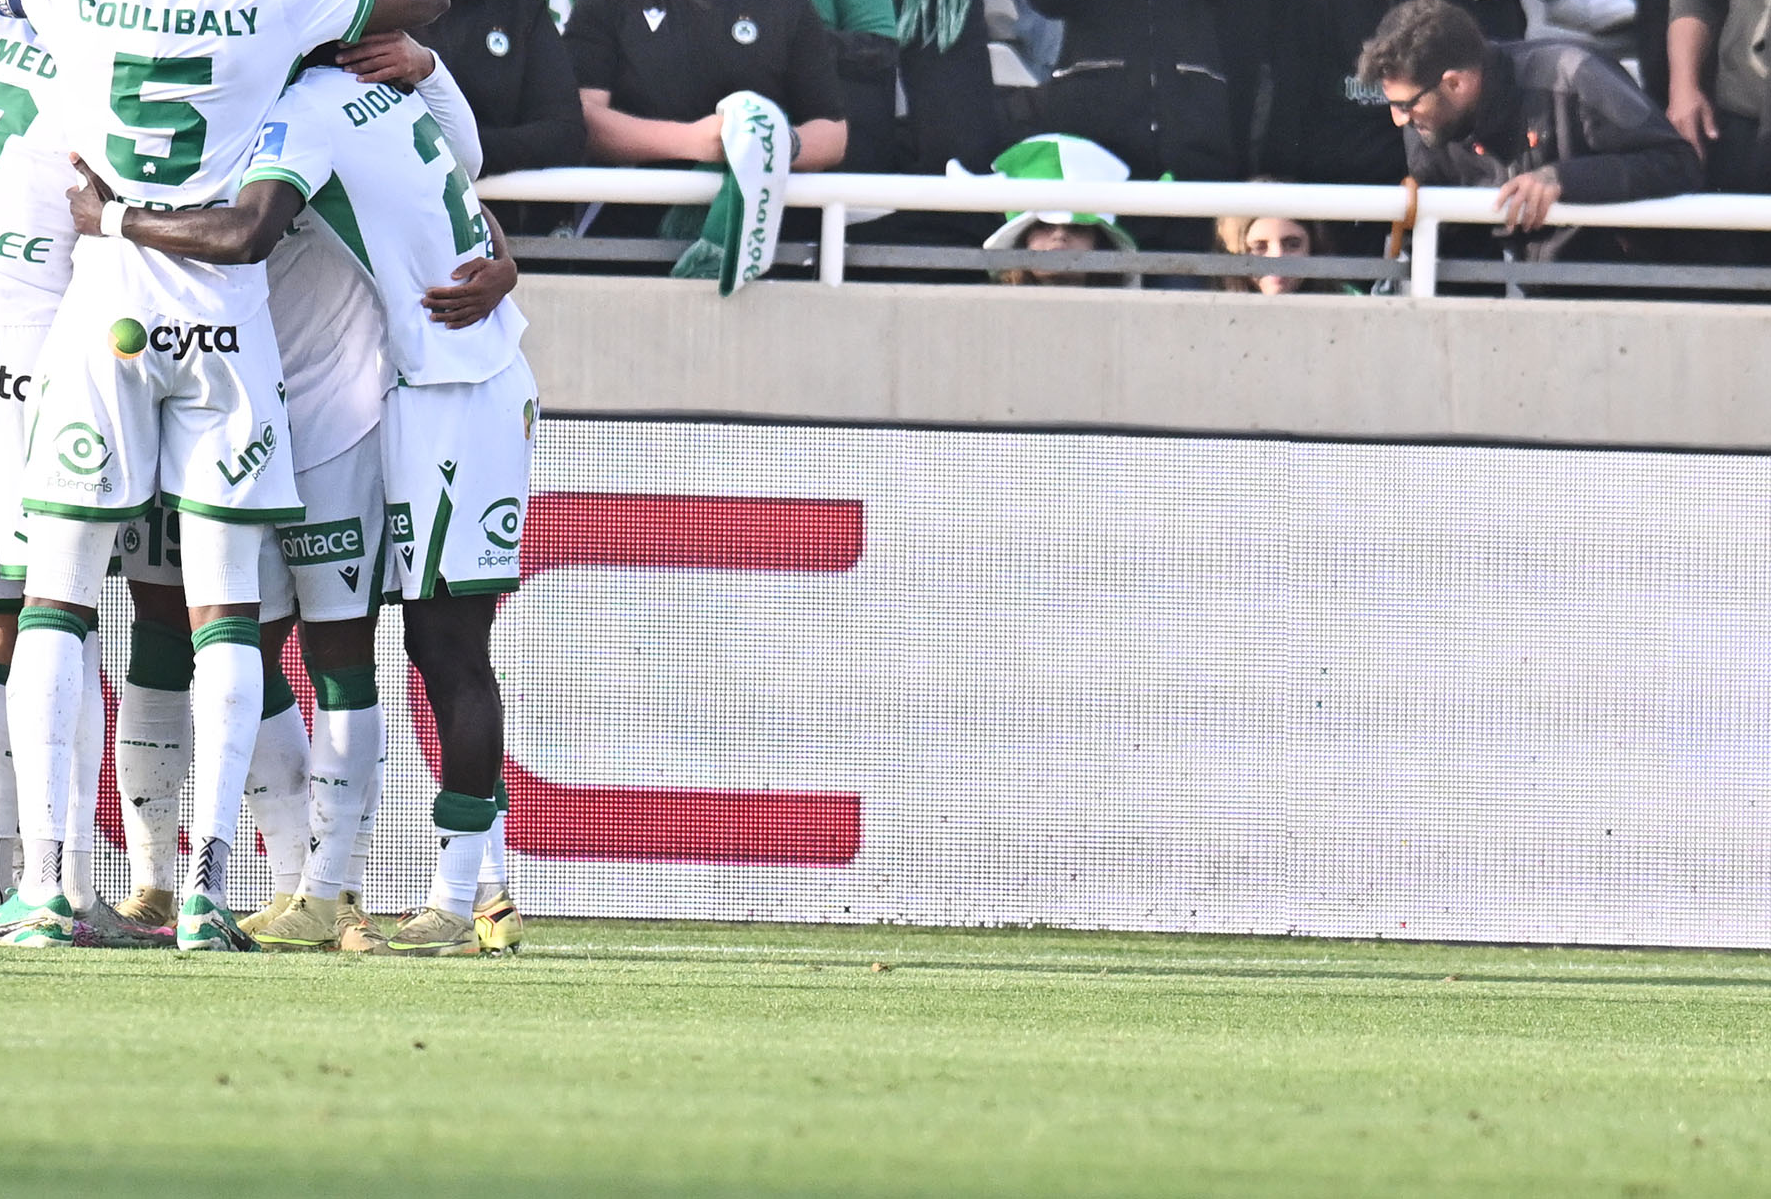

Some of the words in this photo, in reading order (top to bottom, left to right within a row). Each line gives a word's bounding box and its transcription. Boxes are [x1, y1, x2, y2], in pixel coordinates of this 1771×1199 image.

[106, 52, 213, 187] 5
[149, 324, 240, 361] cyta
[215, 423, 275, 487] Line
